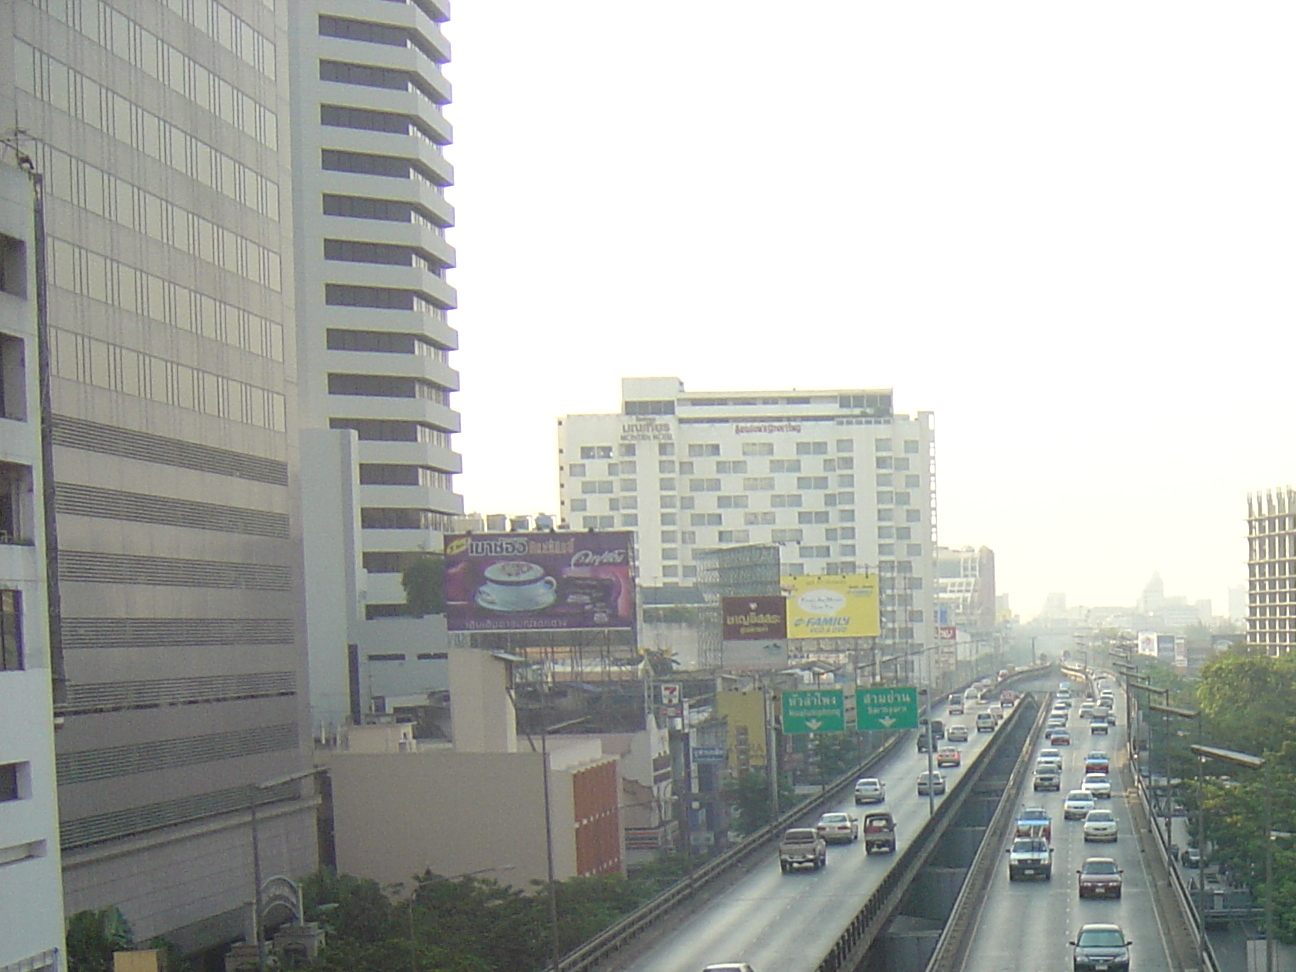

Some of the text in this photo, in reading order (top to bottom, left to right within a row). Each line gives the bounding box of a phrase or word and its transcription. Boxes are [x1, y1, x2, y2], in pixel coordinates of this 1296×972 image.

[805, 616, 851, 627] FAMILY
[863, 690, 911, 704] สามย่าน
